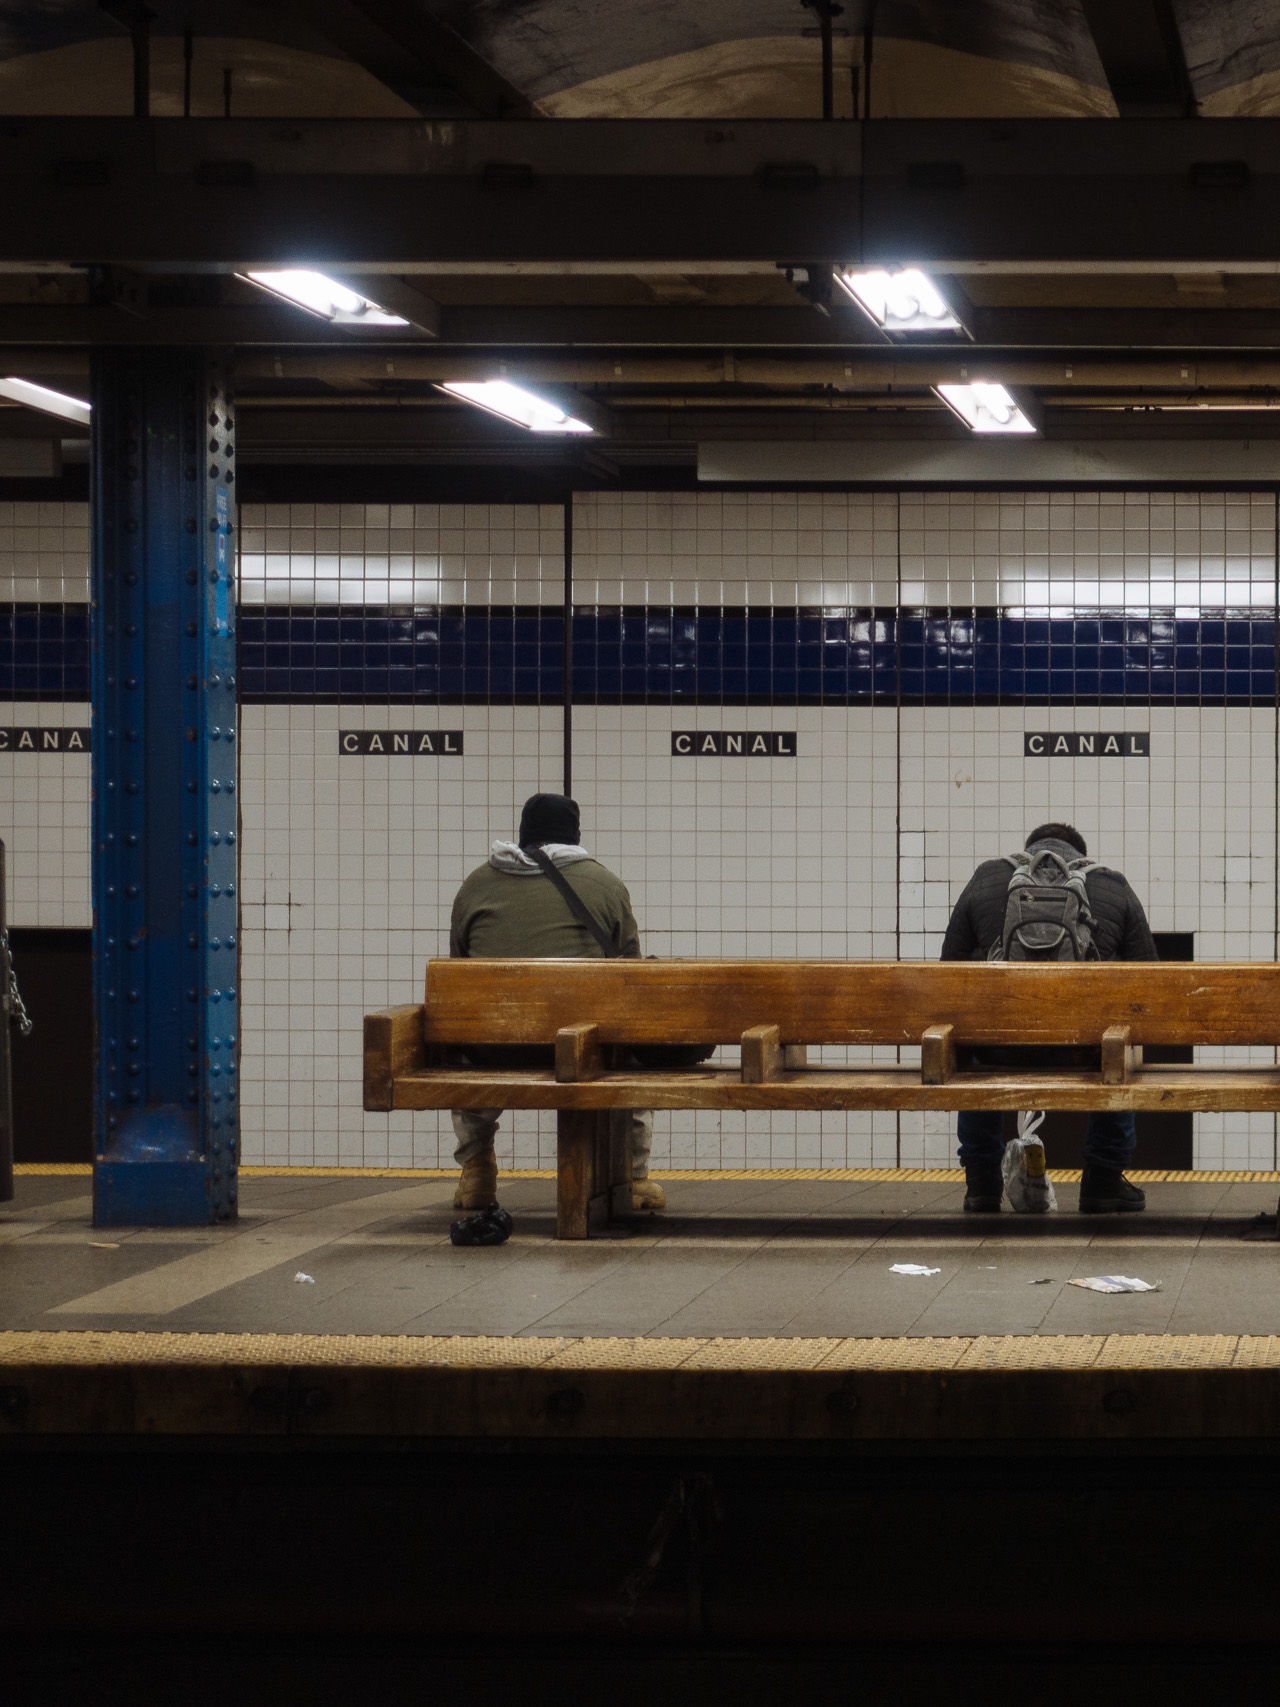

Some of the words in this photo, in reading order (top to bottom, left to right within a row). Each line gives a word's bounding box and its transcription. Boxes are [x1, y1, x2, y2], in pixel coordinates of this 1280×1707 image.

[0, 730, 84, 749] CANA
[343, 733, 457, 752] CANAL
[675, 734, 791, 753] CANAL
[1028, 735, 1144, 754] CANAL
